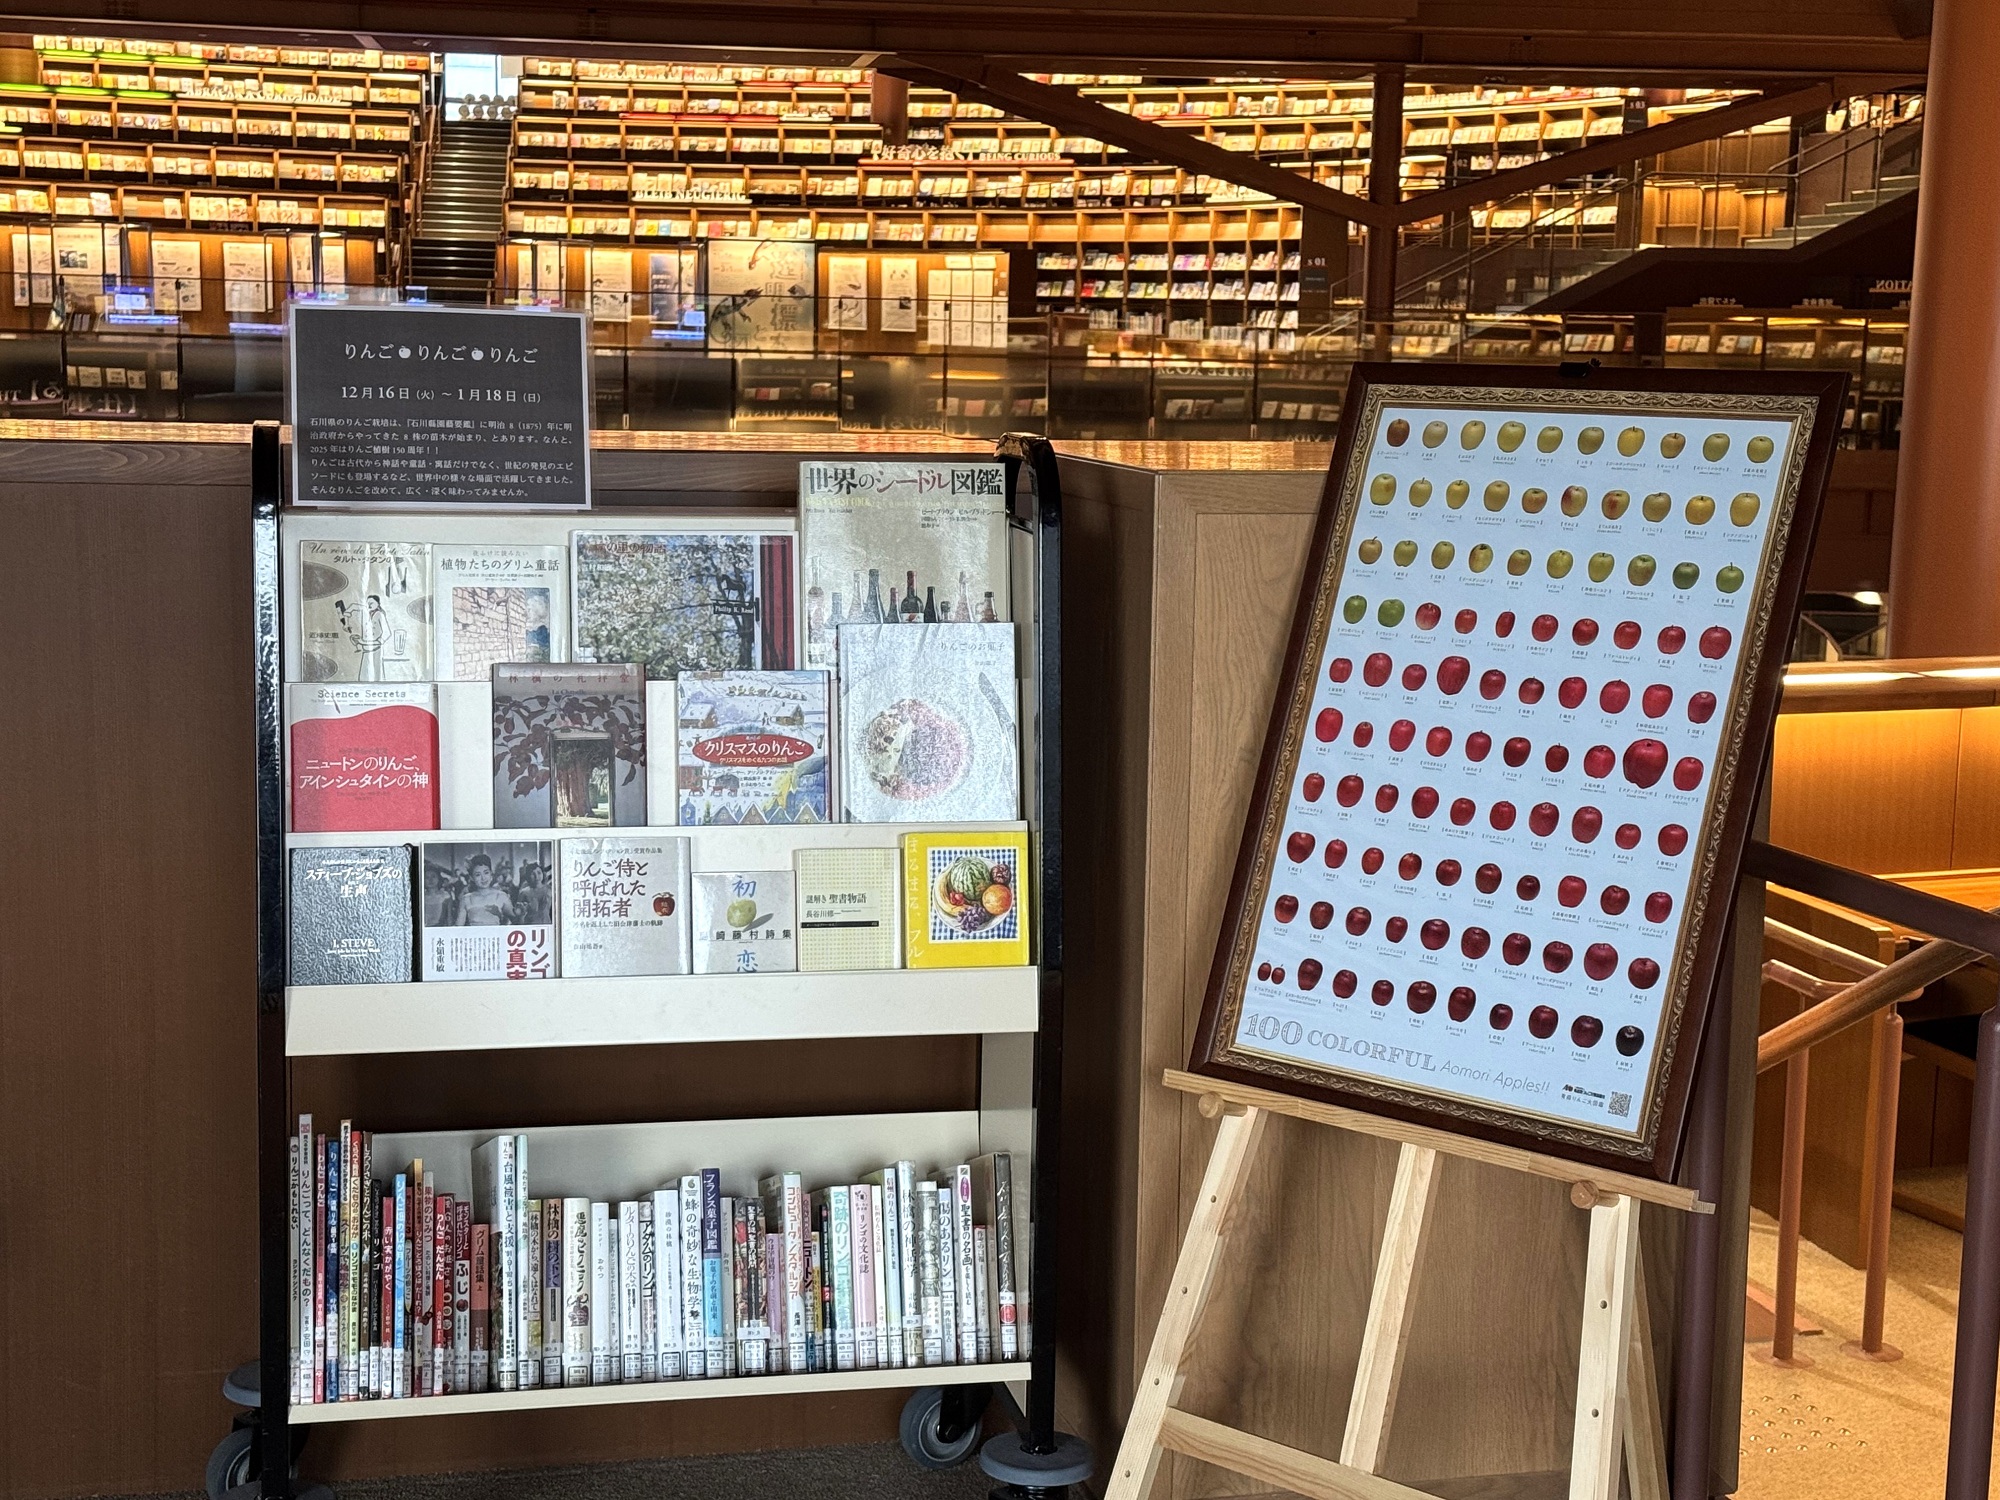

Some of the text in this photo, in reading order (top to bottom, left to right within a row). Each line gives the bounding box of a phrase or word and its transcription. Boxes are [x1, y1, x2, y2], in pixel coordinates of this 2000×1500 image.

[345, 343, 538, 363] りんご りんご りんご
[806, 468, 1003, 495] 世界のシードル図鑑
[441, 558, 560, 571] 植物たちのグリム童話
[318, 690, 406, 698] Science Secrets
[704, 740, 806, 756] クリスマスのりんご
[306, 755, 420, 771] ニュートンのりんご、
[299, 772, 428, 789] アインシュタインの神
[573, 858, 649, 878] りんご侍と
[572, 878, 646, 898] 呼ばれた
[732, 875, 757, 898] 初
[573, 898, 632, 918] 開拓者
[829, 893, 867, 904] 聖書物語
[341, 939, 376, 948] STEVE
[700, 930, 792, 941] 崎藤村詩集
[736, 950, 758, 972] 恋
[1244, 1013, 1303, 1045] 100
[1307, 1030, 1436, 1072] COLORFUL
[1440, 1060, 1491, 1081] Aomori
[1493, 1071, 1550, 1095] Apples!!
[291, 1156, 299, 1230] りんごかもしれない
[704, 1174, 718, 1250] フランス菓子図鑑
[833, 1190, 849, 1279] 奇跡のリンゴ
[859, 1214, 870, 1274] リンゴの文化誌
[939, 1203, 952, 1278] 傷のあるリン
[436, 1214, 444, 1280] りんご だんだん
[685, 1198, 701, 1310] 蜂の奇妙な生物学
[642, 1220, 655, 1298] アダムのリンゴ
[803, 1240, 813, 1288] ニュートン
[456, 1263, 468, 1295] ふじ
